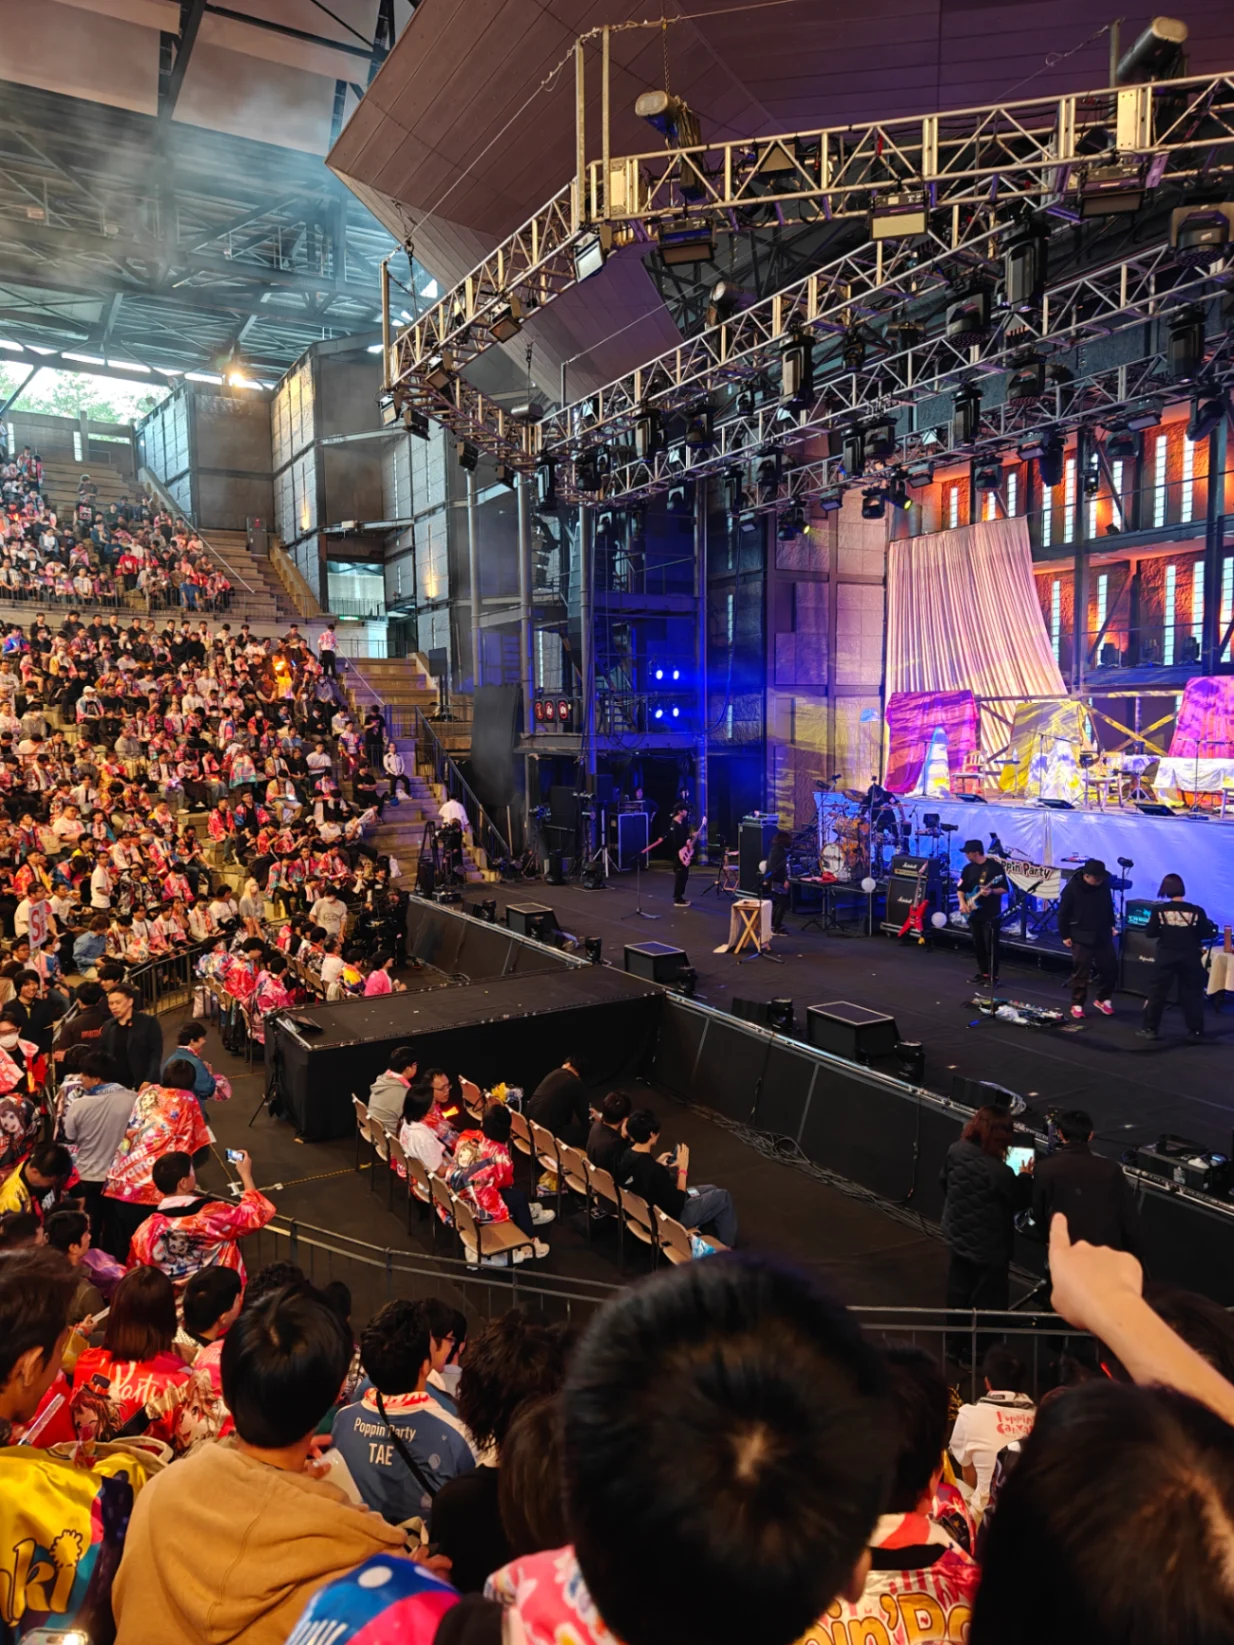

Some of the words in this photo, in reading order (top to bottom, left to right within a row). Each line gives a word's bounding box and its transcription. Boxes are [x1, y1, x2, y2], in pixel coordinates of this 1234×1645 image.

[1023, 863, 1050, 879] Party
[32, 909, 40, 941] S
[354, 1417, 386, 1438] Poppin
[387, 1424, 416, 1443] Party
[369, 1443, 394, 1466] TAE
